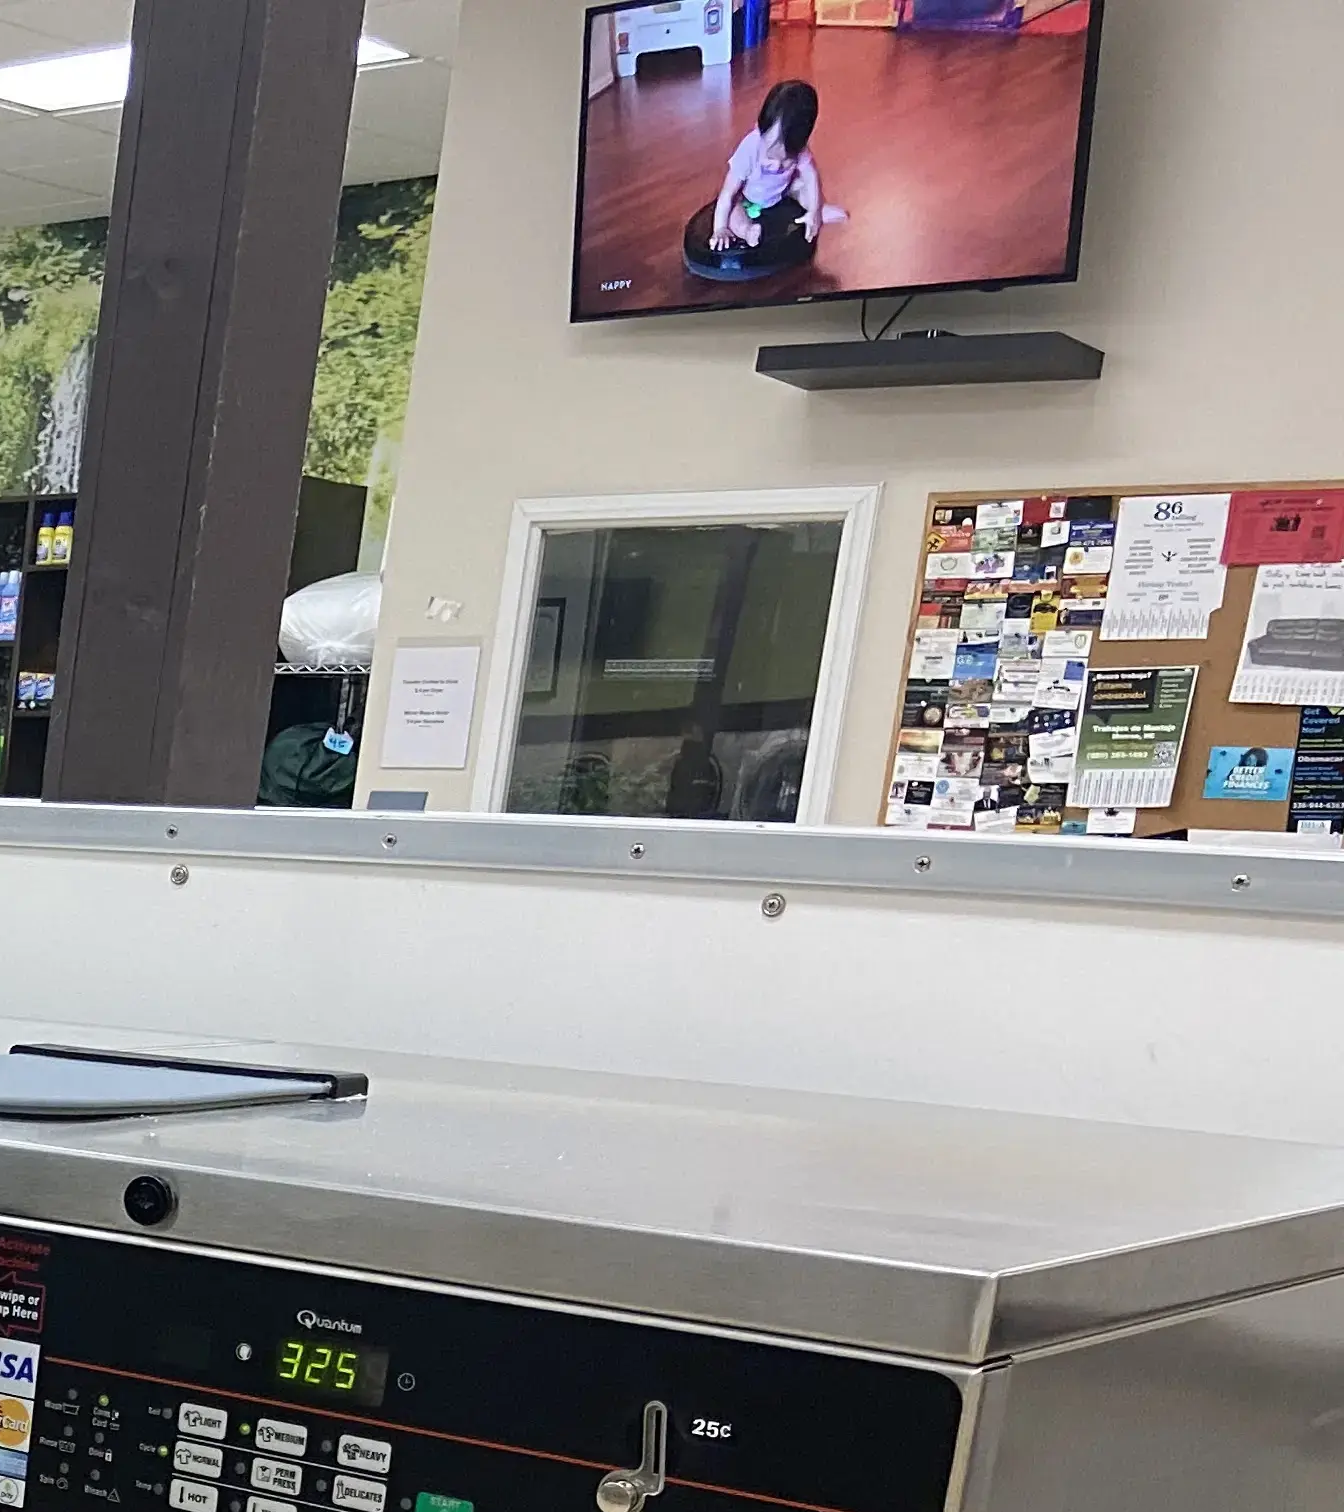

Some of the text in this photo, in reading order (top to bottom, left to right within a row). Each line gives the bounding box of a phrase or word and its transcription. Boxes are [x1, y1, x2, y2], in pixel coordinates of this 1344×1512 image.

[600, 279, 632, 291] HAPPY
[1154, 501, 1183, 521] 86
[28, 1296, 40, 1306] or
[12, 1305, 39, 1320] Here
[296, 1309, 362, 1334] Quantum
[279, 1342, 357, 1390] 325
[199, 1416, 222, 1430] LIGHT
[274, 1431, 305, 1446] MEDIUM
[192, 1454, 220, 1468] NORMAL
[359, 1446, 387, 1463] HEAVY
[275, 1467, 296, 1480] PERM
[272, 1478, 296, 1492] PRESS
[187, 1493, 208, 1504] HOT
[344, 1488, 383, 1504] DELICATES
[429, 1496, 462, 1510] START
